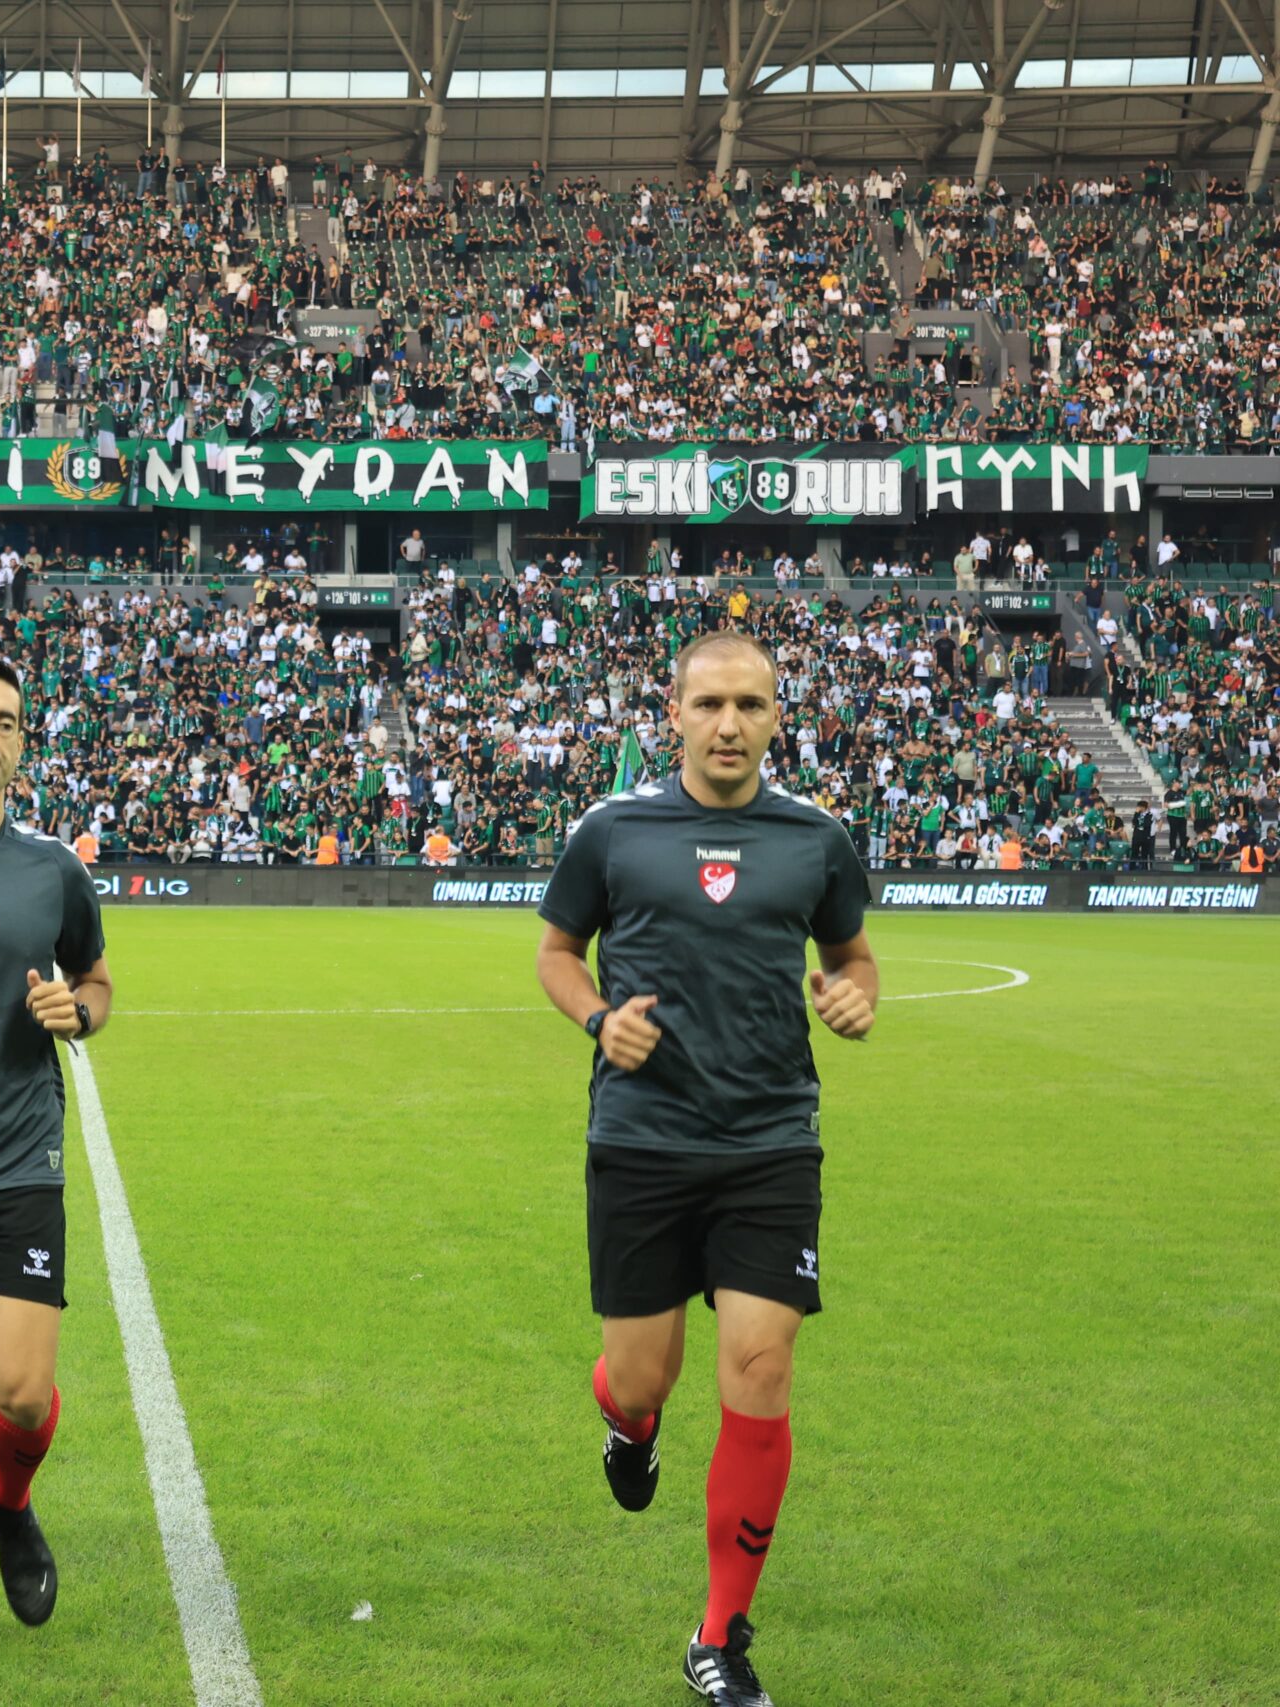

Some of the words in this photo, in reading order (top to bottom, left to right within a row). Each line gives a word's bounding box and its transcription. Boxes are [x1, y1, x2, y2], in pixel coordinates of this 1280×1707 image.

[309, 325, 322, 338] 327
[325, 325, 338, 338] 301
[915, 325, 929, 338] 301
[932, 325, 945, 338] 302
[71, 457, 101, 479] 89
[145, 445, 530, 508] MEYDAN
[596, 450, 711, 514] ESKİ
[756, 471, 789, 500] 89
[793, 460, 902, 515] RUH
[331, 591, 344, 604] 126
[349, 591, 361, 605] 101
[991, 595, 1003, 609] 101
[1009, 595, 1022, 609] 102
[696, 846, 741, 862] hummel
[489, 880, 550, 902] DESTE
[881, 883, 973, 905] FORMANLA
[974, 881, 1048, 906] GÖSTER!
[1087, 885, 1168, 906] TAKIMINA
[1169, 883, 1259, 908] DESTEĞİNİ
[23, 1264, 51, 1279] hummel
